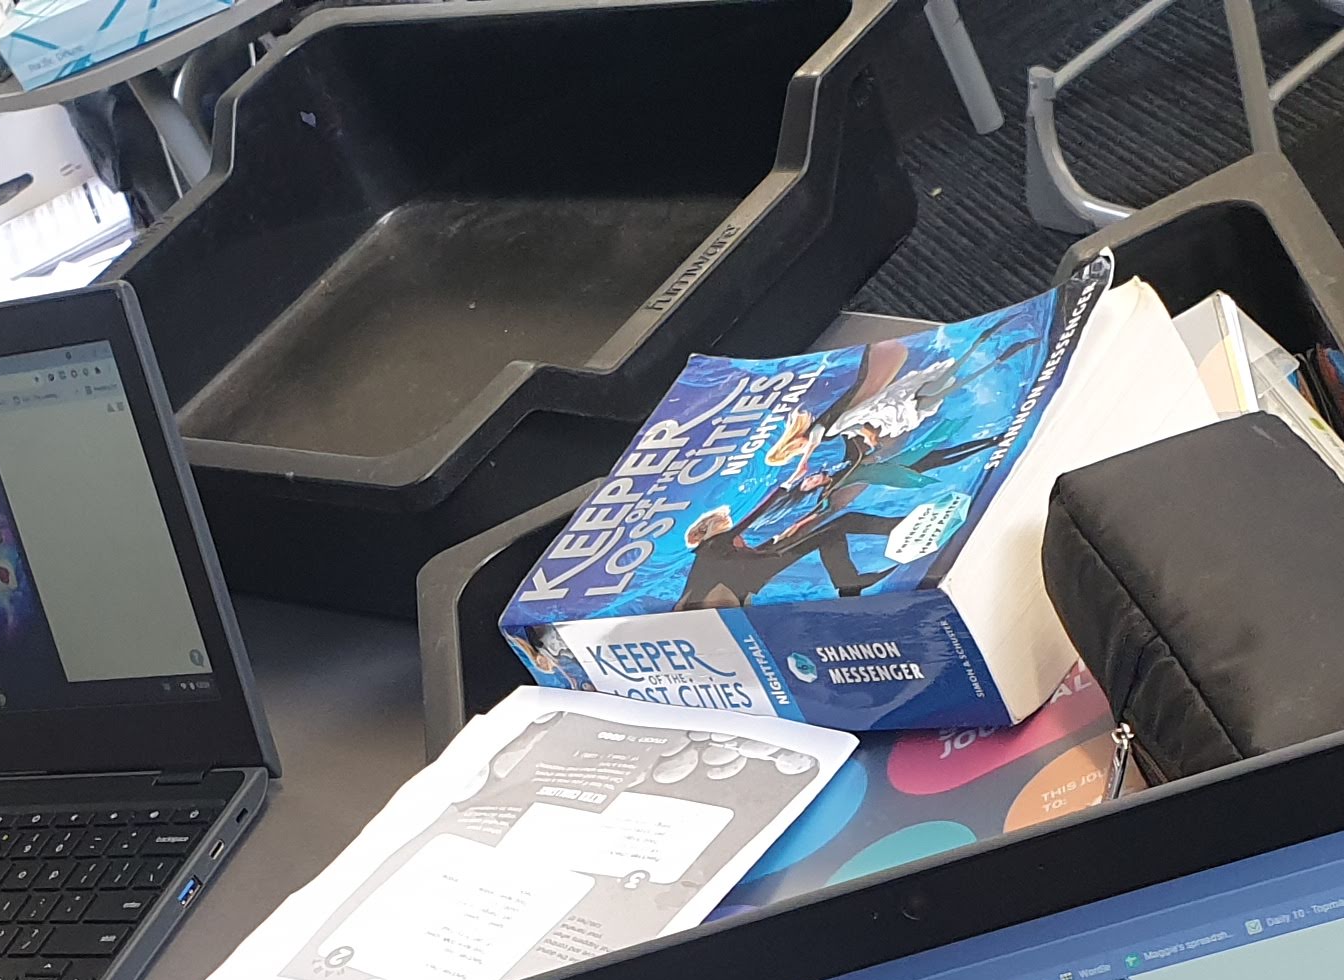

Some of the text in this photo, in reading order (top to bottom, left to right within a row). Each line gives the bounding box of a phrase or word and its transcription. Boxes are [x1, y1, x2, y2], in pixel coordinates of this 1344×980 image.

[984, 281, 1098, 472] SHANNON MESSENGER
[720, 365, 827, 476] NIGHTFALL
[519, 377, 750, 602] KEEPER
[584, 459, 691, 597] LOST OF THE
[895, 507, 932, 554] Perfect for
[919, 496, 961, 554] Harry Potter
[585, 638, 737, 683] KEEPER
[742, 633, 791, 706] NIGHTFALL
[815, 641, 902, 663] SHANNON
[829, 662, 926, 685] MESSENGER
[647, 673, 686, 686] OF THE
[966, 669, 986, 699] SIMON
[1040, 781, 1078, 803] THIS
[1042, 801, 1068, 813] TO:
[1077, 963, 1112, 980] Wordle
[1265, 913, 1291, 929] Daily
[1291, 907, 1306, 921] 10
